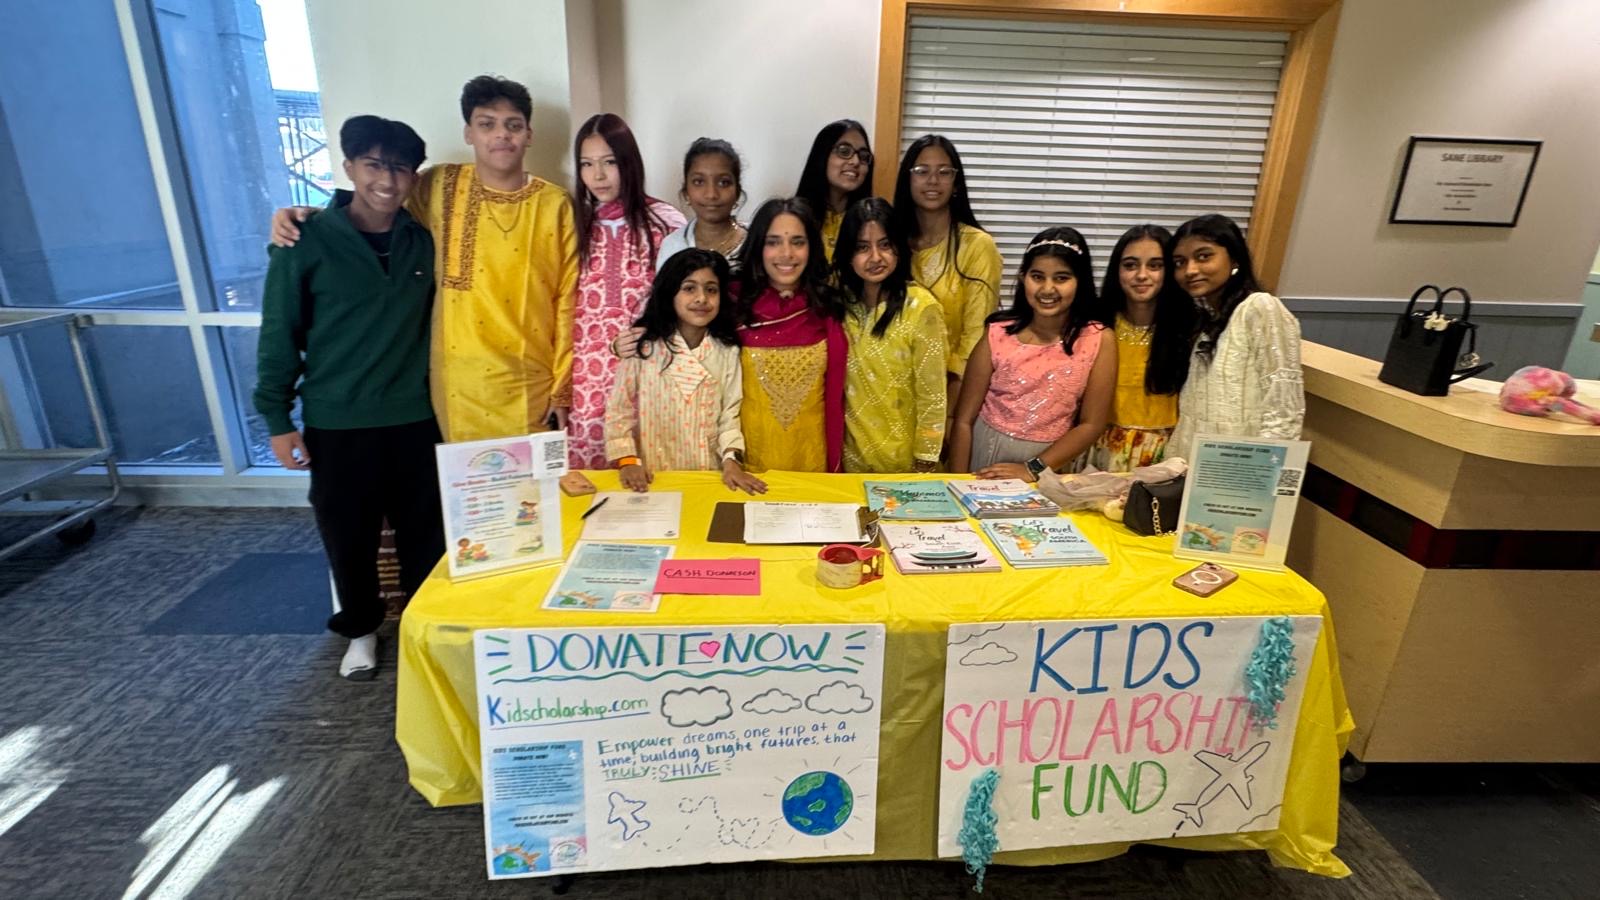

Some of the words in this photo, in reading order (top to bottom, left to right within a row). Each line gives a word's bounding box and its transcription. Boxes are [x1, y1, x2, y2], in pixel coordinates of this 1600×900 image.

[1035, 524, 1073, 534] Travel
[663, 568, 701, 577] CASH
[527, 631, 713, 672] DONATE
[723, 631, 831, 663] NOW
[1029, 621, 1214, 694] KIDS
[487, 694, 649, 725] Kidscholarship.com
[597, 736, 673, 755] Empower
[743, 727, 770, 739] one
[777, 724, 806, 737] trip
[811, 721, 828, 732] at
[838, 720, 846, 731] a
[640, 747, 701, 763] building
[706, 741, 753, 758] bright
[824, 731, 857, 743] that
[658, 759, 721, 780] SHINE
[1031, 760, 1168, 820] FUND
